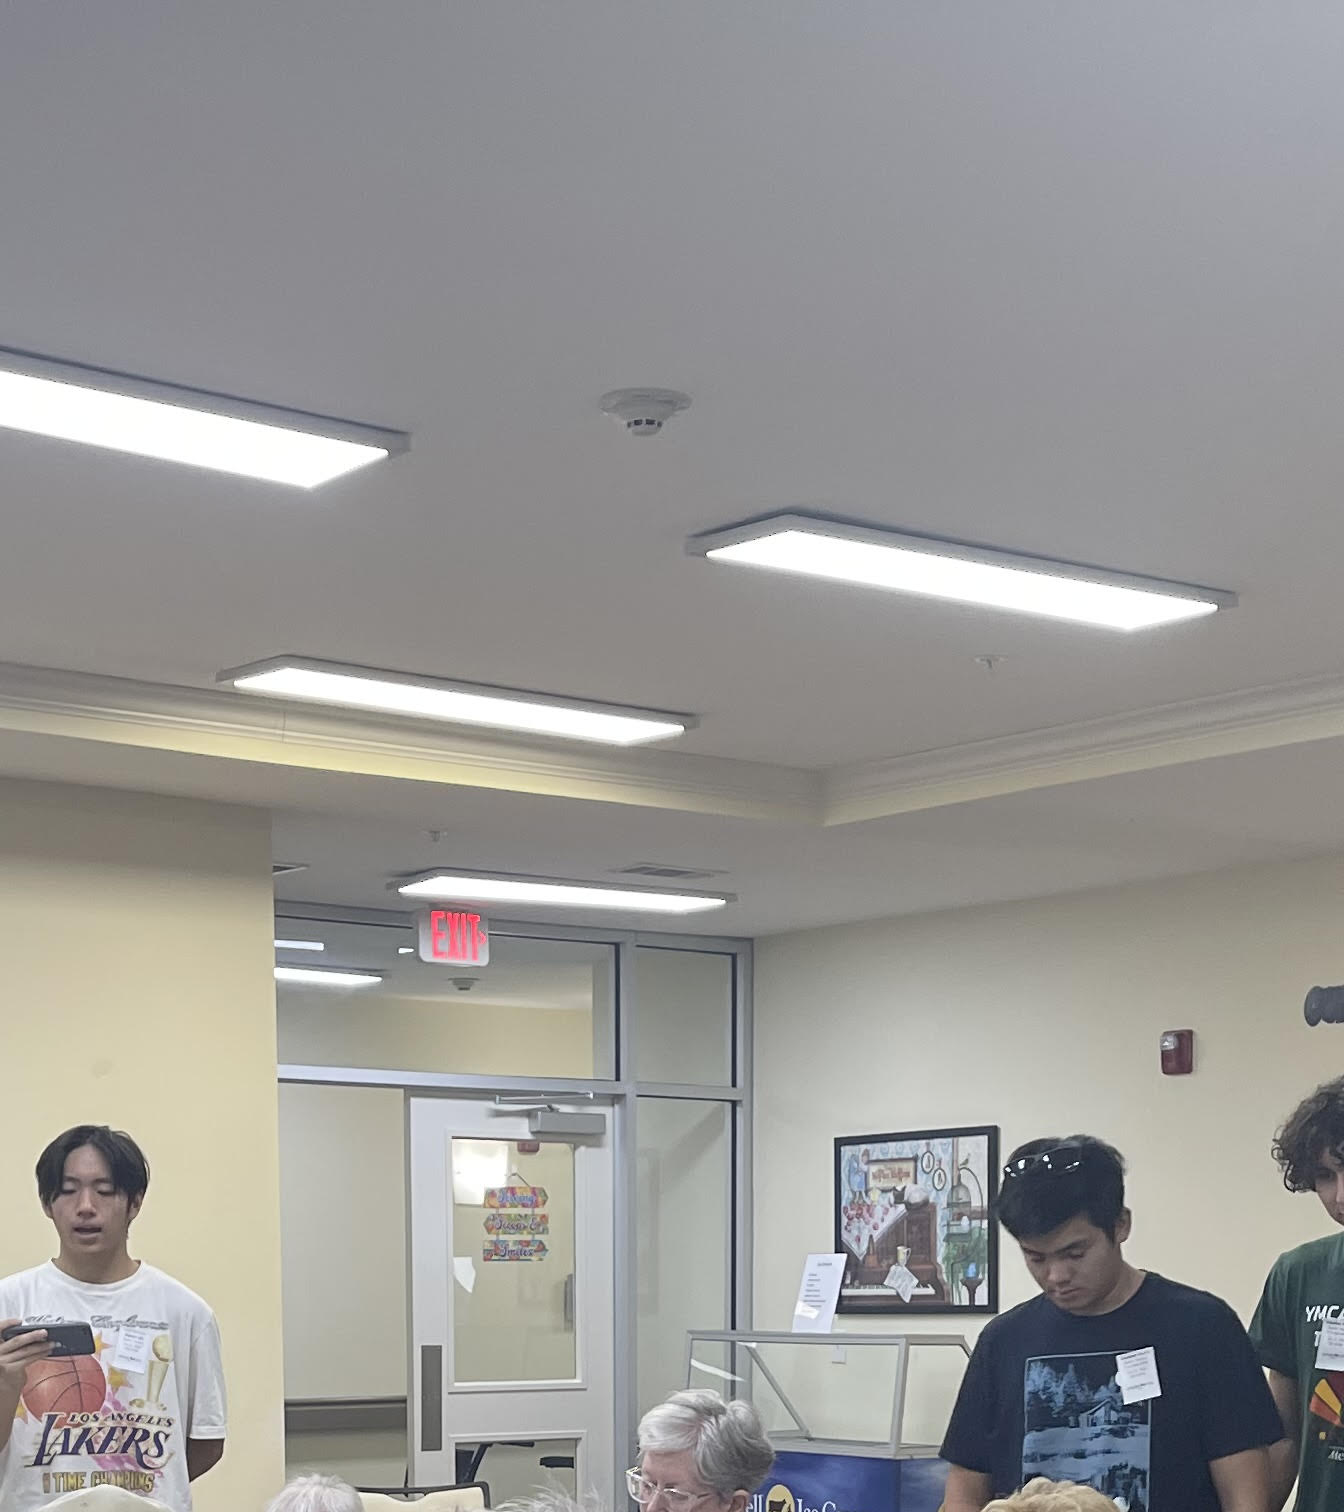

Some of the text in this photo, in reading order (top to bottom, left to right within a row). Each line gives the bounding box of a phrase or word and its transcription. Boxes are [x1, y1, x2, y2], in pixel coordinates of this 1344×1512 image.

[430, 910, 481, 961] EXIT
[67, 1412, 174, 1428] LOS ANGELES
[28, 1413, 170, 1470] LAKERS
[52, 1471, 86, 1493] TIME
